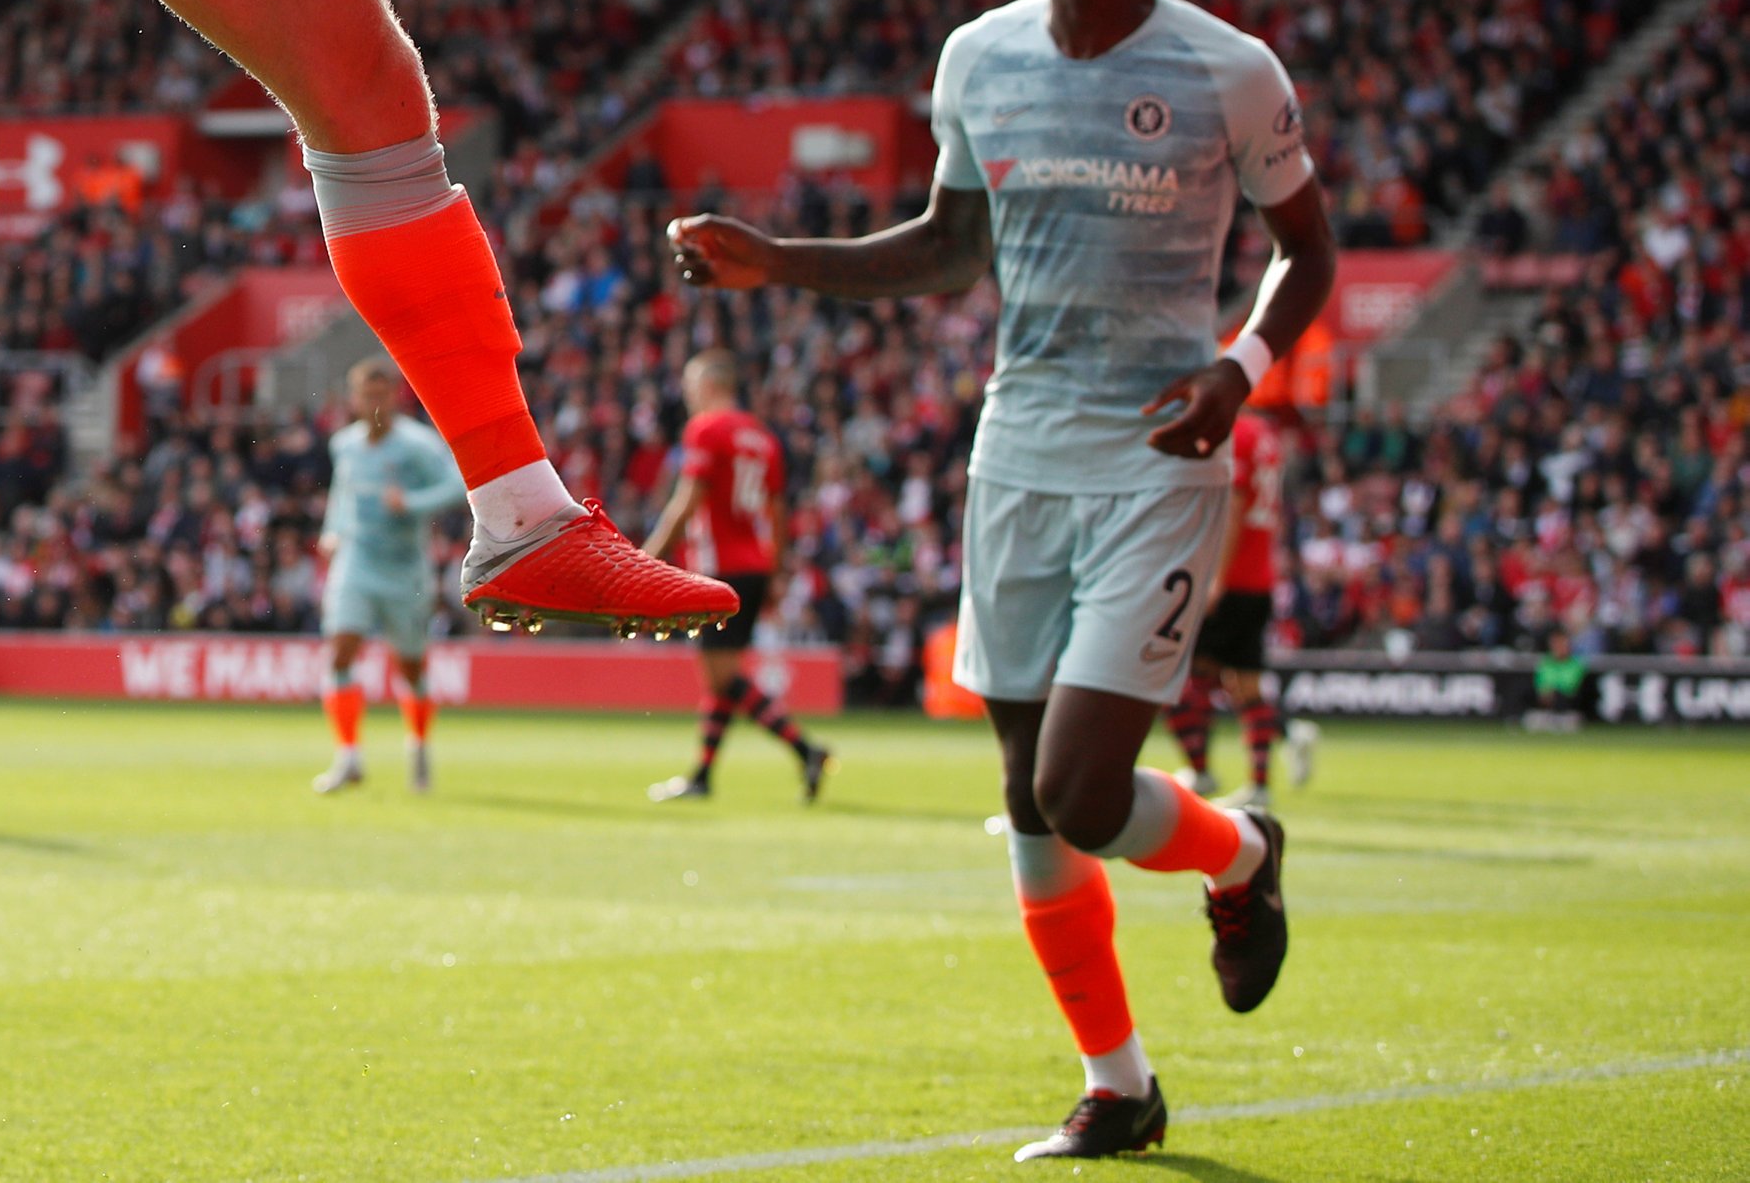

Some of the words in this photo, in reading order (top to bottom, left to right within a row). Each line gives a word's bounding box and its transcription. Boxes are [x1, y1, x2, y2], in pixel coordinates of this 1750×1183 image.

[1020, 158, 1179, 191] YOKOHAMA
[1107, 190, 1175, 213] TYRES
[1155, 569, 1193, 642] 2
[123, 641, 198, 697] WE
[1284, 672, 1495, 714] ARMOUR
